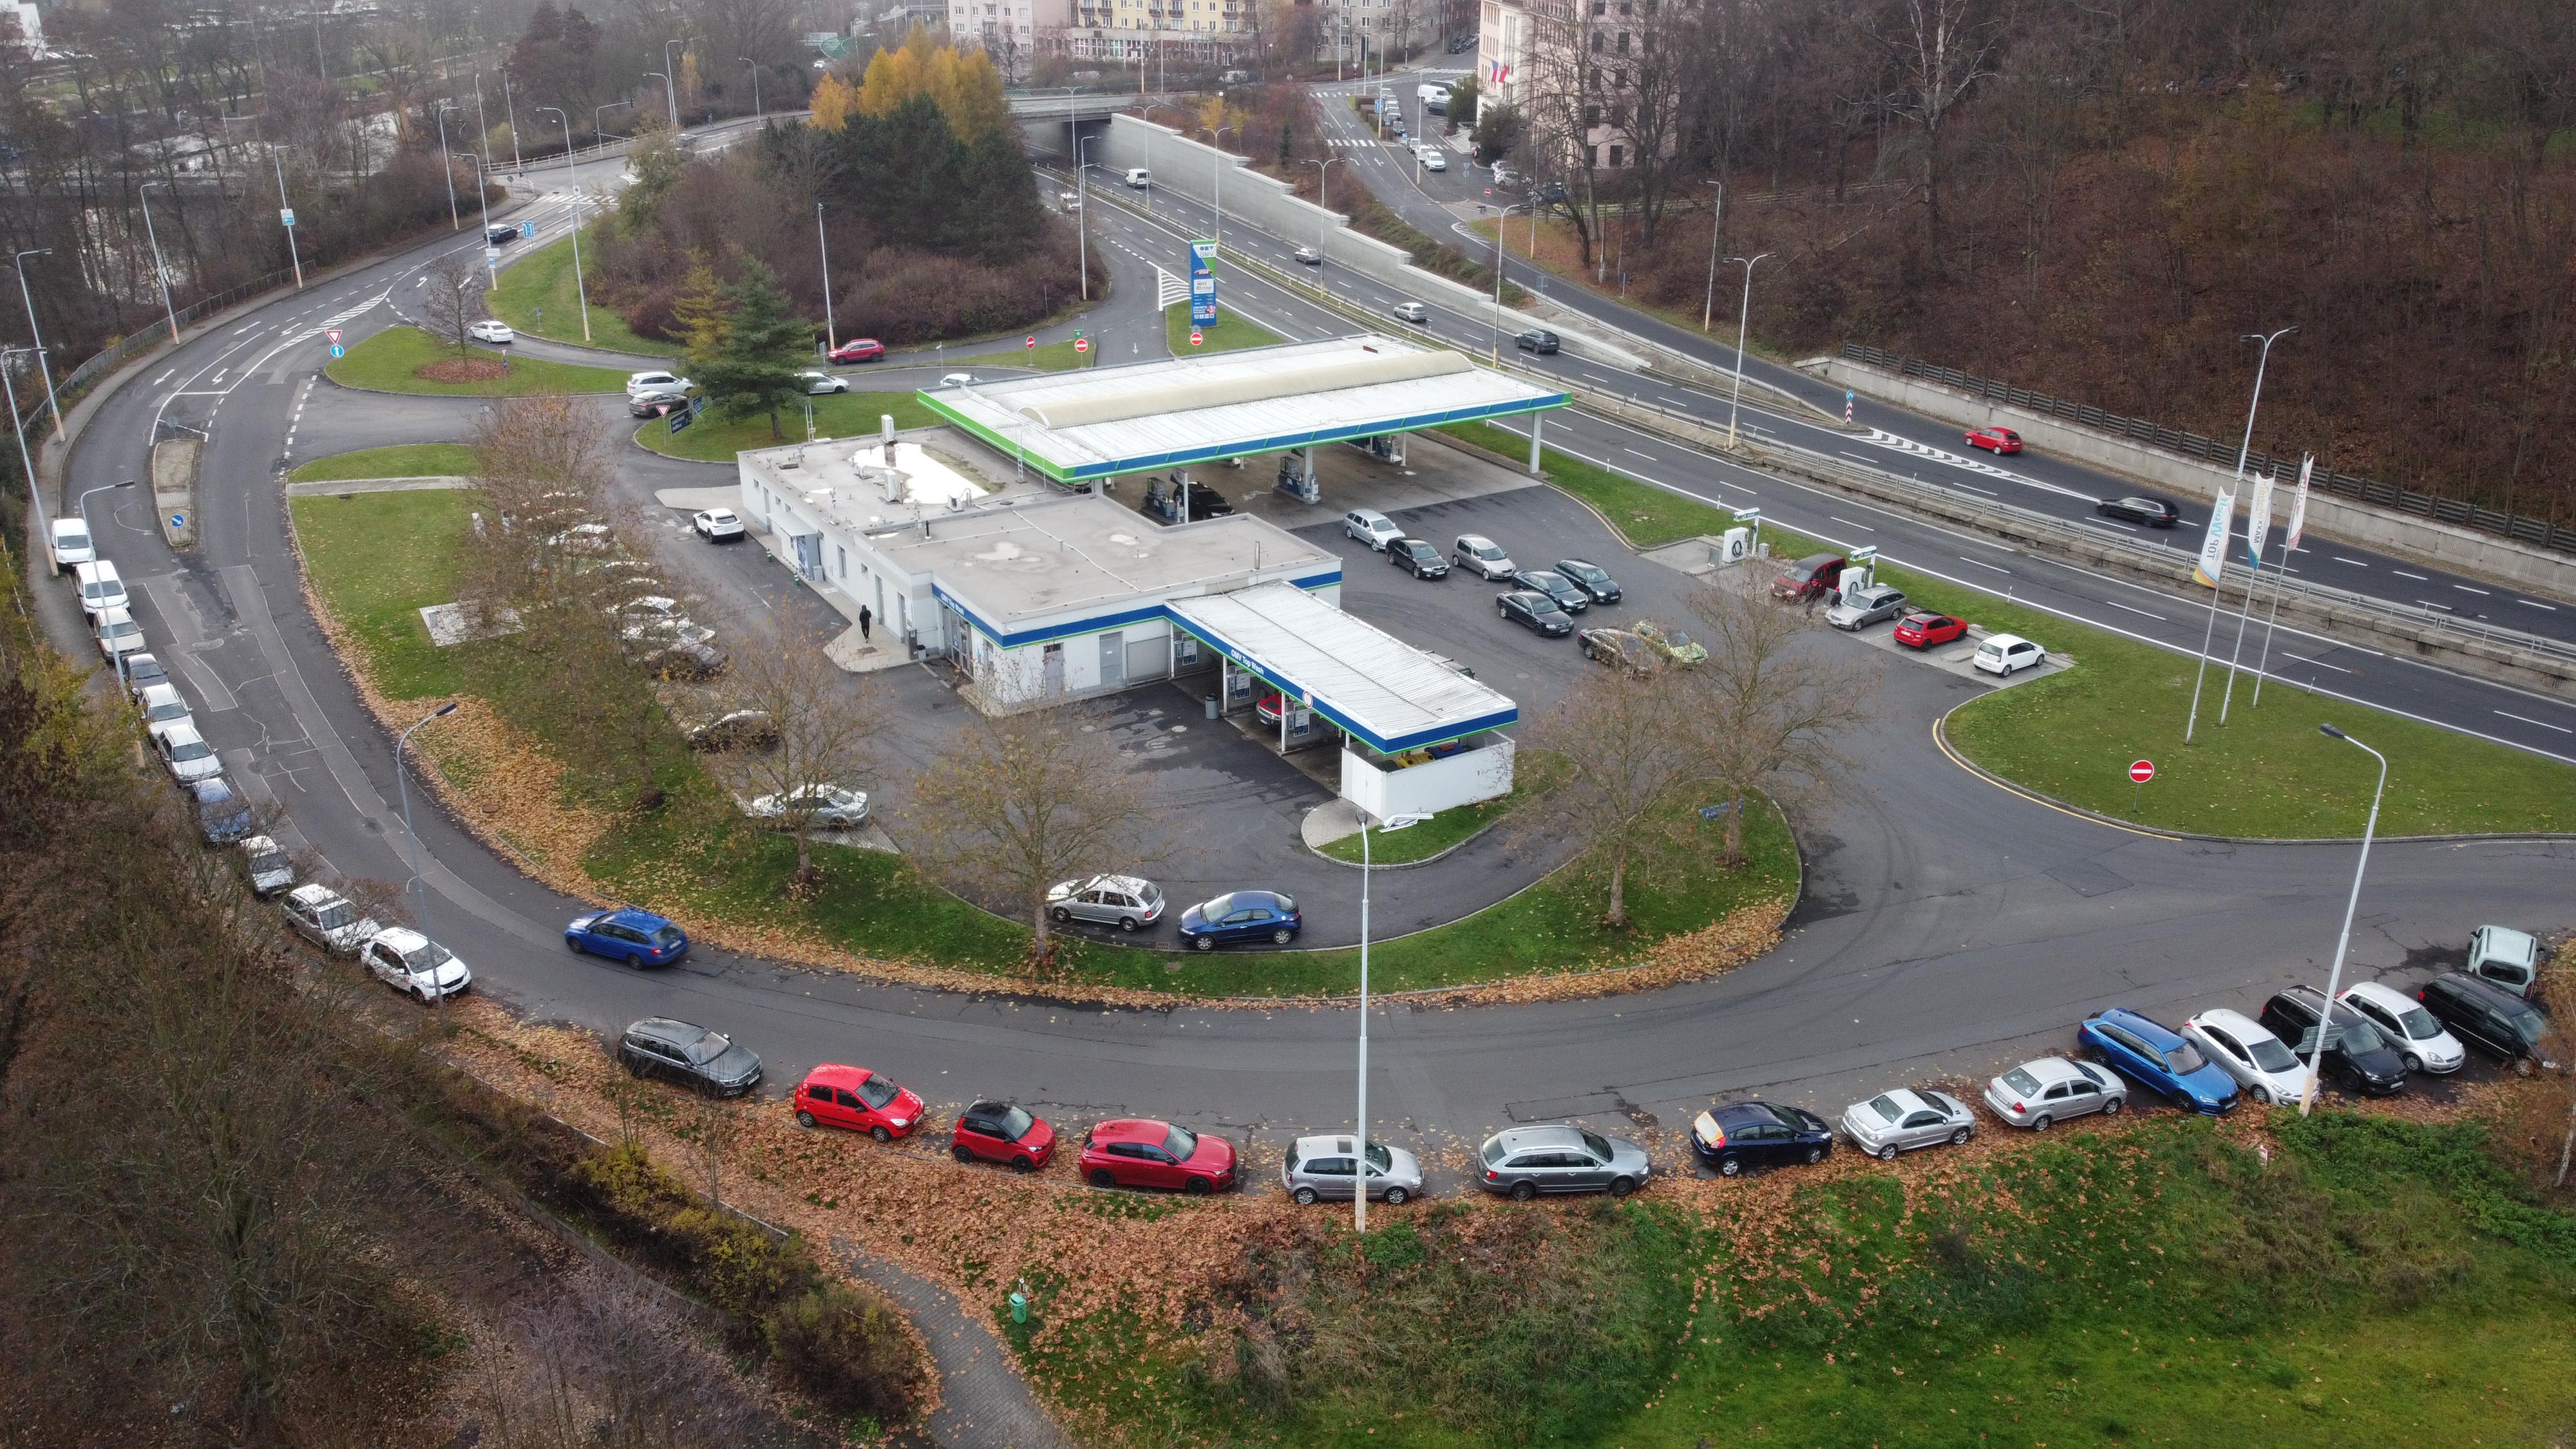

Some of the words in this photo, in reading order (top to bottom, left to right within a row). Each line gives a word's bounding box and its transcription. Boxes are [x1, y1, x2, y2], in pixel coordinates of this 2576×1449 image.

[1231, 649, 1242, 661] OMV
[1242, 656, 1251, 667] Top
[1251, 661, 1264, 676] Wash
